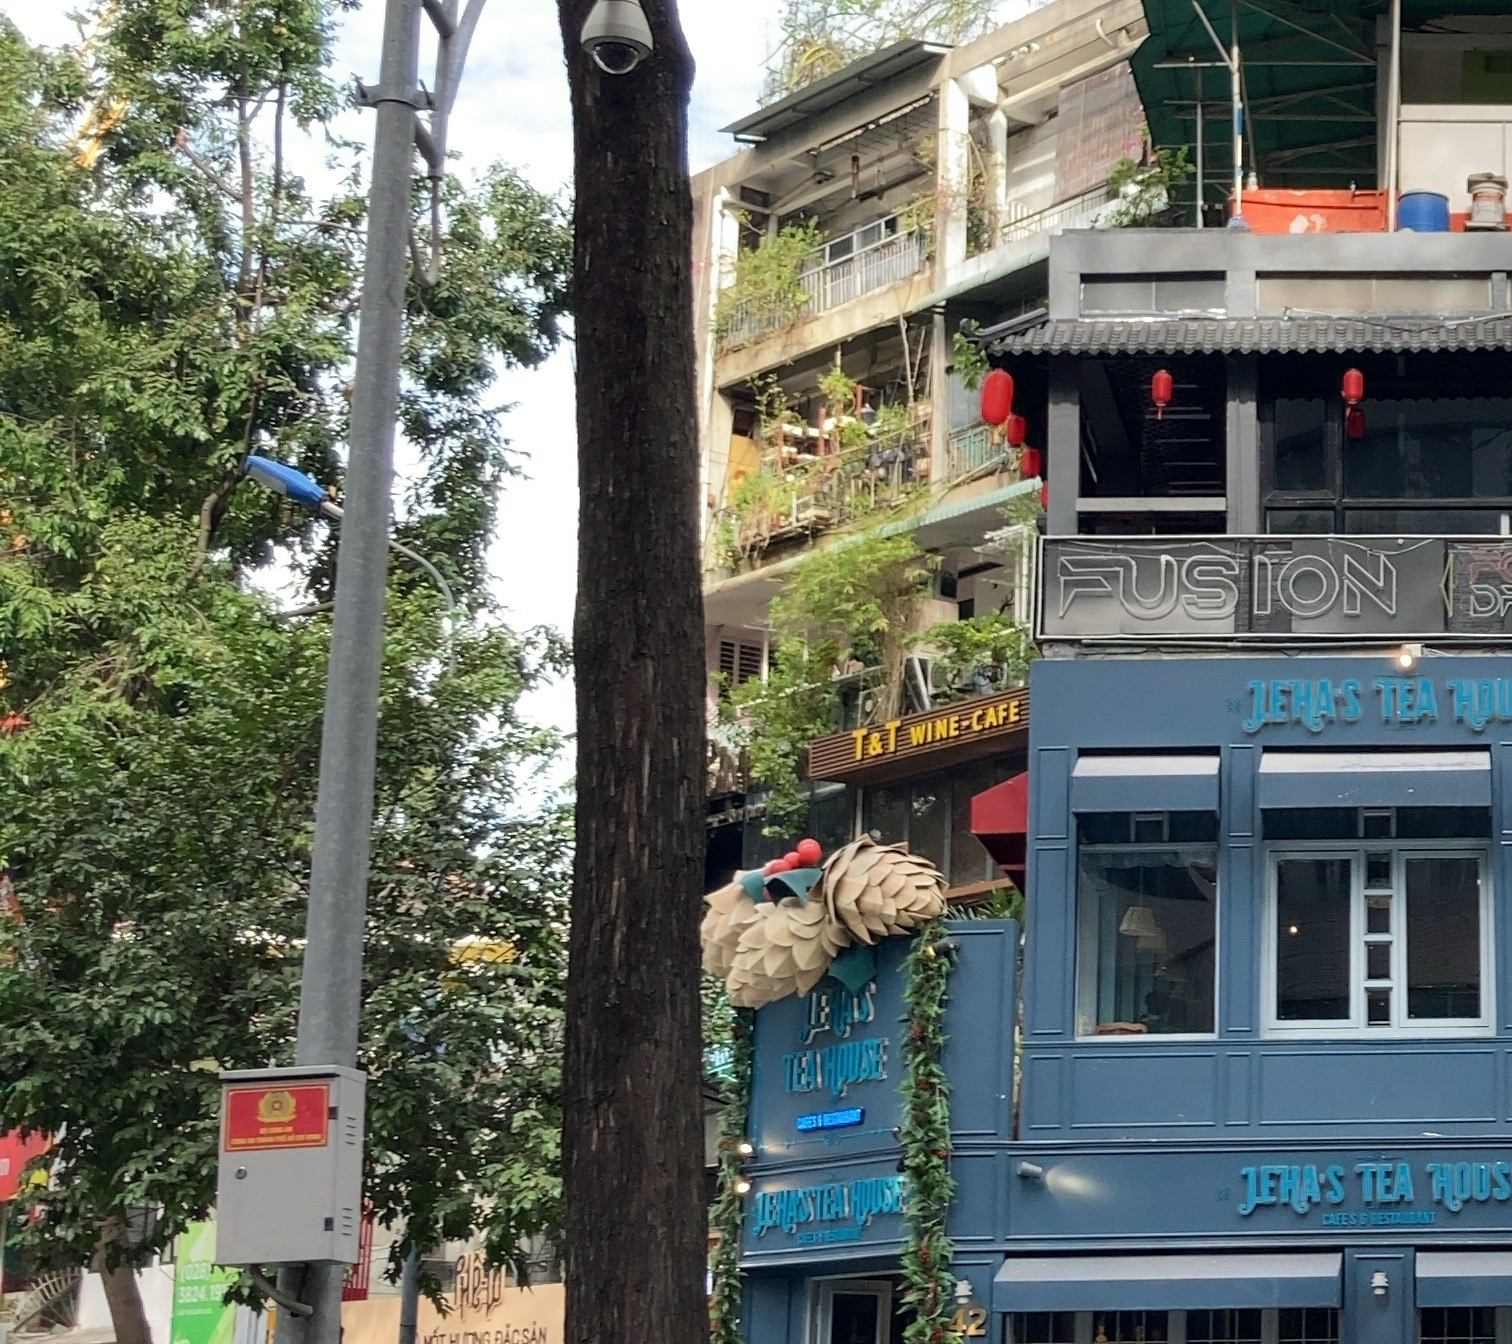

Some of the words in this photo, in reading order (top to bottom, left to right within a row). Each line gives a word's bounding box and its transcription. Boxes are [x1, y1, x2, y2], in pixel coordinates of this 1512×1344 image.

[1057, 554, 1397, 620] FUSION
[1373, 678, 1439, 723] TEA
[852, 720, 901, 761] T&T
[910, 700, 1020, 747] WINE-CAFE
[783, 1049, 822, 1092] TEA
[823, 1038, 889, 1098] HOUSE
[1354, 1162, 1415, 1203] TEA
[950, 1308, 987, 1337] 42
